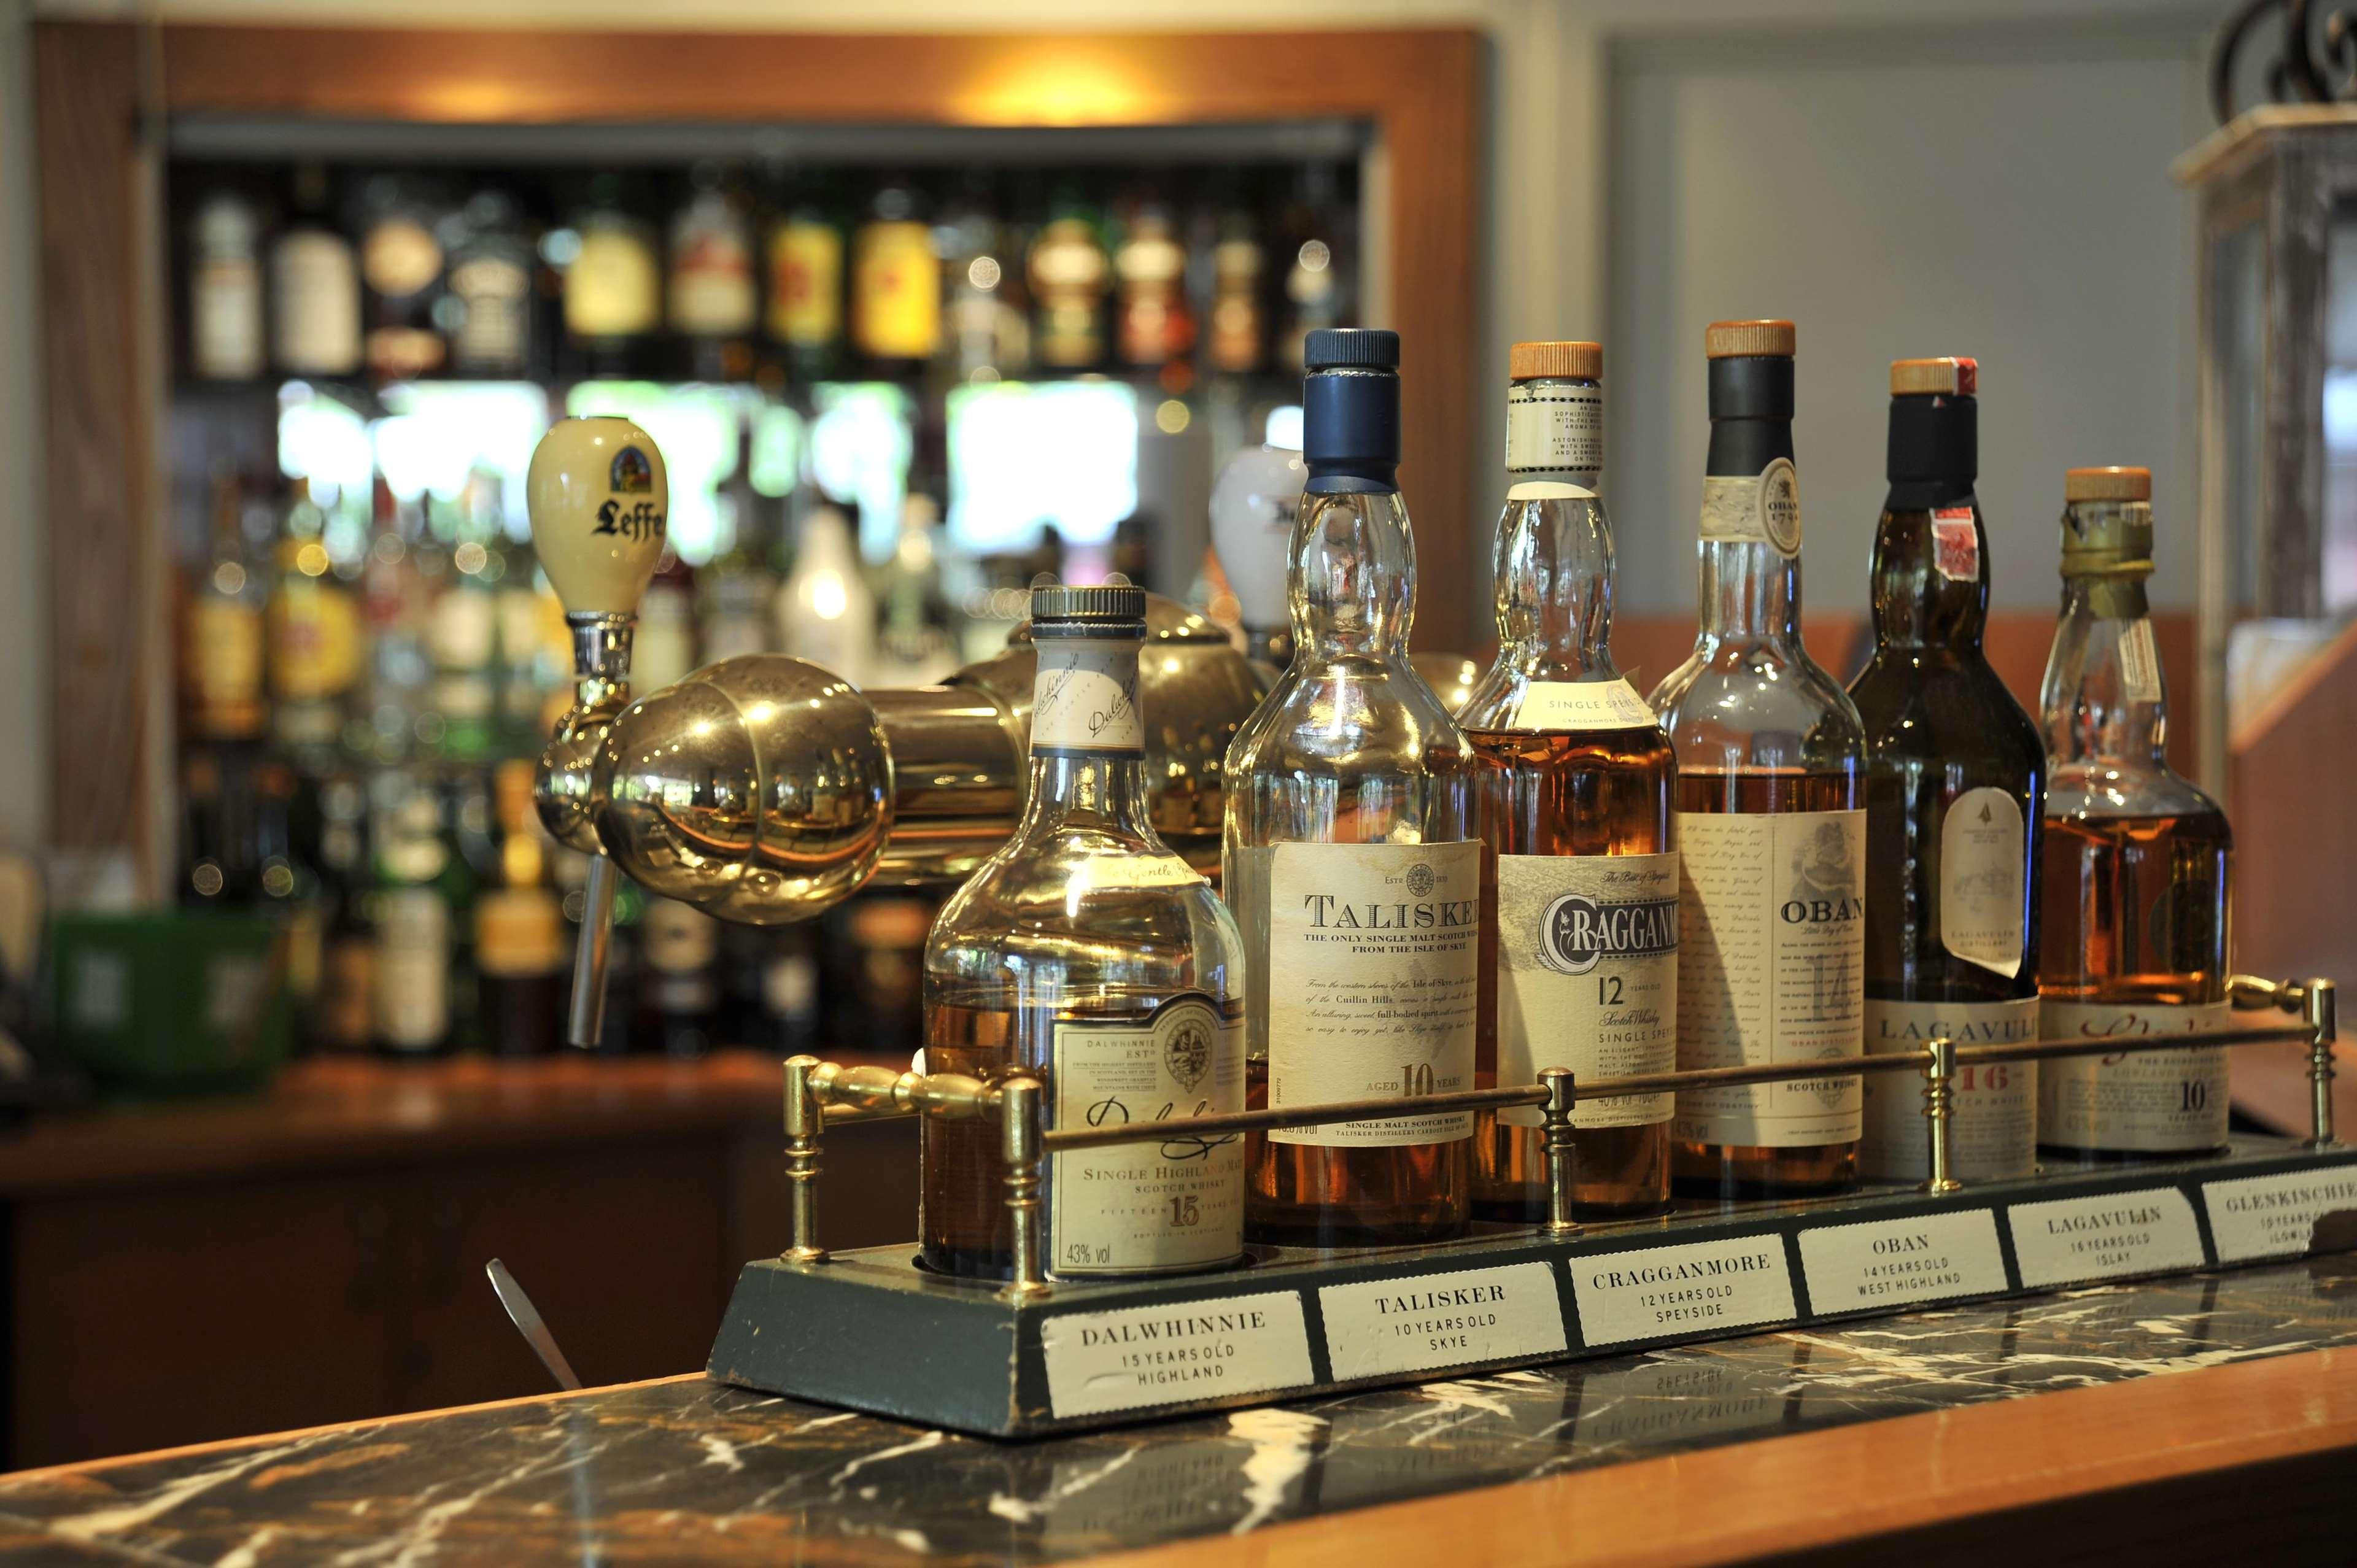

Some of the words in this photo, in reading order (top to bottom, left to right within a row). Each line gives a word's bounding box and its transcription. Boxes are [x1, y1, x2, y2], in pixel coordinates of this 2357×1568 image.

[590, 500, 663, 541] Leffe
[1549, 700, 1601, 709] SINGLE
[1781, 897, 1864, 924] OBAN
[1366, 934, 1407, 943] SINGLE
[1438, 931, 1466, 940] SCOTCH
[1450, 942, 1467, 951] SKYE
[1428, 979, 1436, 987] of
[1600, 976, 1624, 1005] 12
[1336, 995, 1368, 1004] Cuillin
[1378, 1010, 1419, 1019] full-bodied
[1421, 1010, 1438, 1019] spirit
[1599, 1032, 1646, 1043] SINGLE
[1366, 1082, 1399, 1092] AGED
[1401, 1063, 1434, 1097] 10
[1437, 1076, 1461, 1088] YEARS
[1787, 1082, 1830, 1092] SCOTCH
[1960, 1066, 2009, 1092] 16
[2181, 1079, 2207, 1112] 10
[1412, 1118, 1443, 1128] SCOTCH
[1083, 1168, 1148, 1181] SINGLE
[1155, 1162, 1225, 1180] HIGHLAND
[1135, 1184, 1185, 1194] SCOTCH
[1190, 1180, 1226, 1190] WHISKY
[1101, 1207, 1166, 1215] FIFTEEN
[1169, 1195, 1200, 1227] 15
[2048, 1205, 2161, 1235] LAGAVULIN
[1067, 1244, 1090, 1264] 43%
[1096, 1244, 1110, 1263] vol
[1873, 1234, 1929, 1255] OBAN
[2096, 1251, 2131, 1267] ISLAY
[1593, 1253, 1771, 1290] CRAGGANMORE
[1857, 1281, 1890, 1296] WEST
[1896, 1272, 1960, 1291] HIGHLAND
[1374, 1284, 1506, 1315] TALISKER
[1656, 1303, 1723, 1323] SPEYSIDE
[1080, 1311, 1266, 1347] DALWHINNIE
[1430, 1335, 1468, 1351] SKYE
[1137, 1365, 1223, 1386] HIGHLAND
